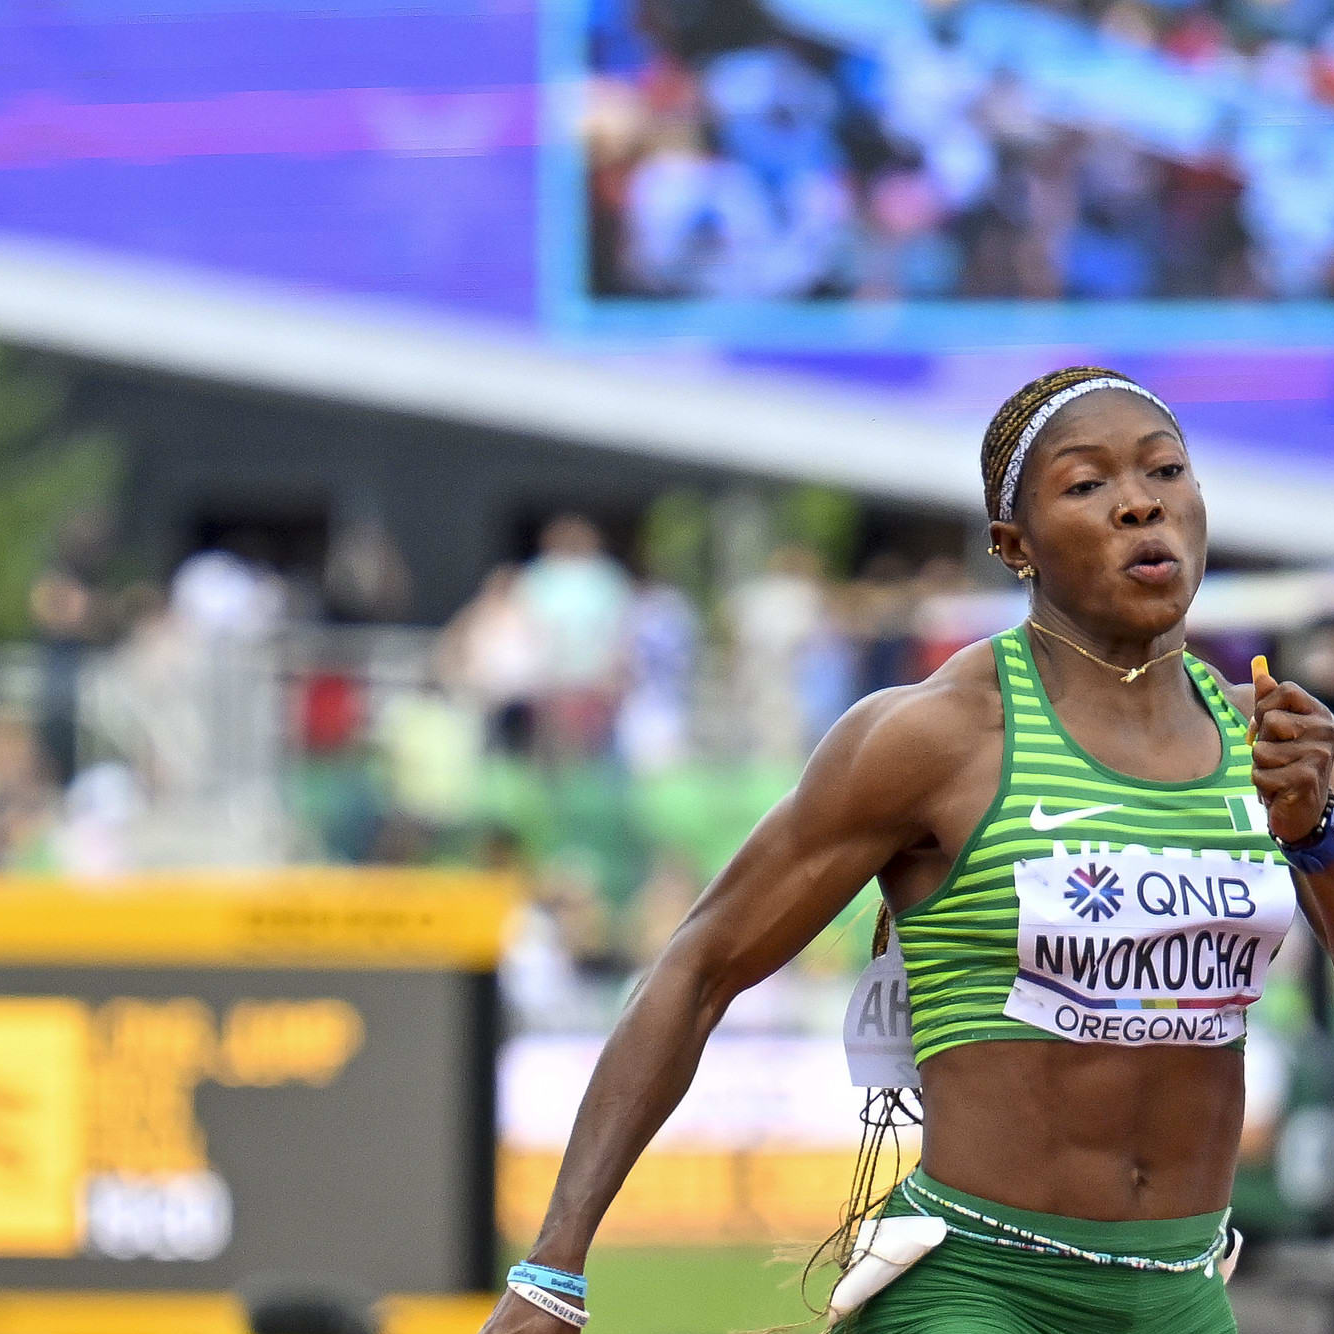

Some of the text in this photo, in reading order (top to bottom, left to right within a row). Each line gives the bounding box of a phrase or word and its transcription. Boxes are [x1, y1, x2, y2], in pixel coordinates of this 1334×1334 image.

[1136, 871, 1256, 918] QNB
[1035, 929, 1260, 990] NWOKOCHA
[1054, 1004, 1229, 1042] OREGON22
